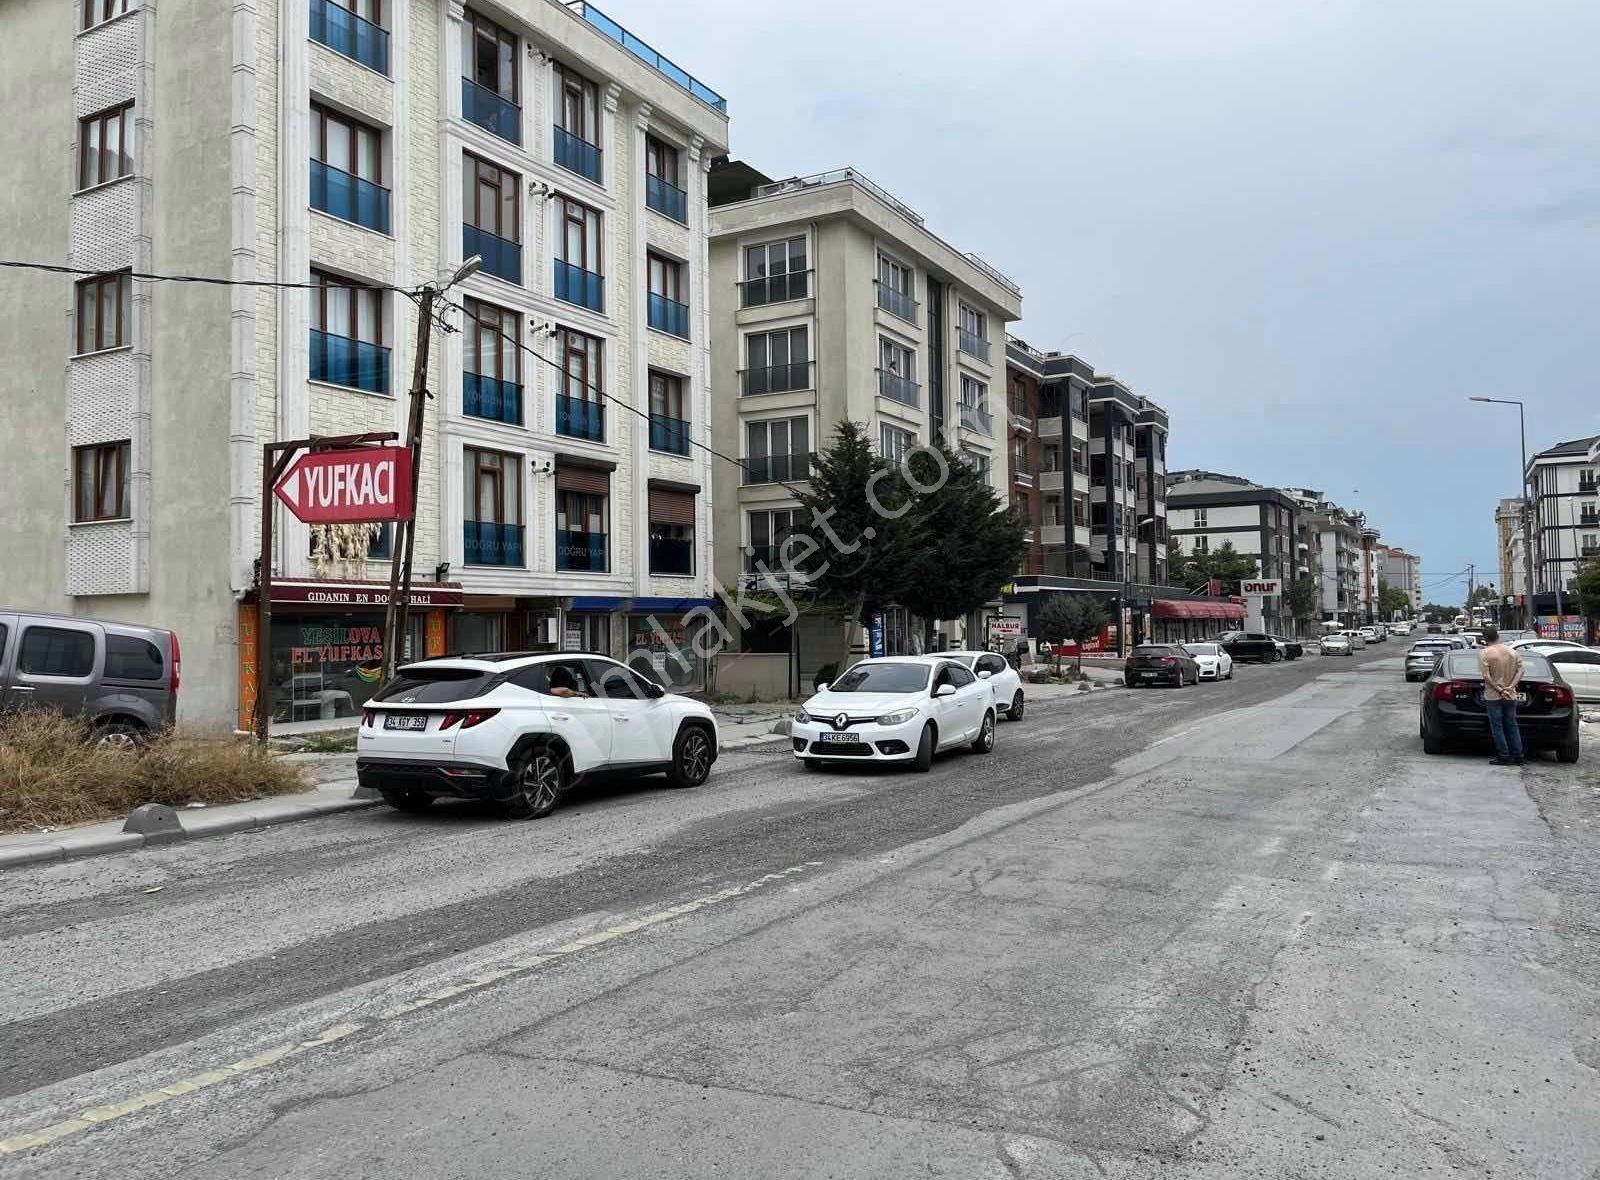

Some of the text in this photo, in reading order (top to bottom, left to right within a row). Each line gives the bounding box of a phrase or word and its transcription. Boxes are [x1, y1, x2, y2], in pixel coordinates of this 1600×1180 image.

[304, 461, 395, 508] YUFKACI
[1244, 582, 1277, 592] onur
[307, 591, 350, 602] GIDANIN
[356, 593, 369, 603] EN
[410, 594, 431, 604] HALİ
[291, 645, 384, 664] EL YUFKAS
